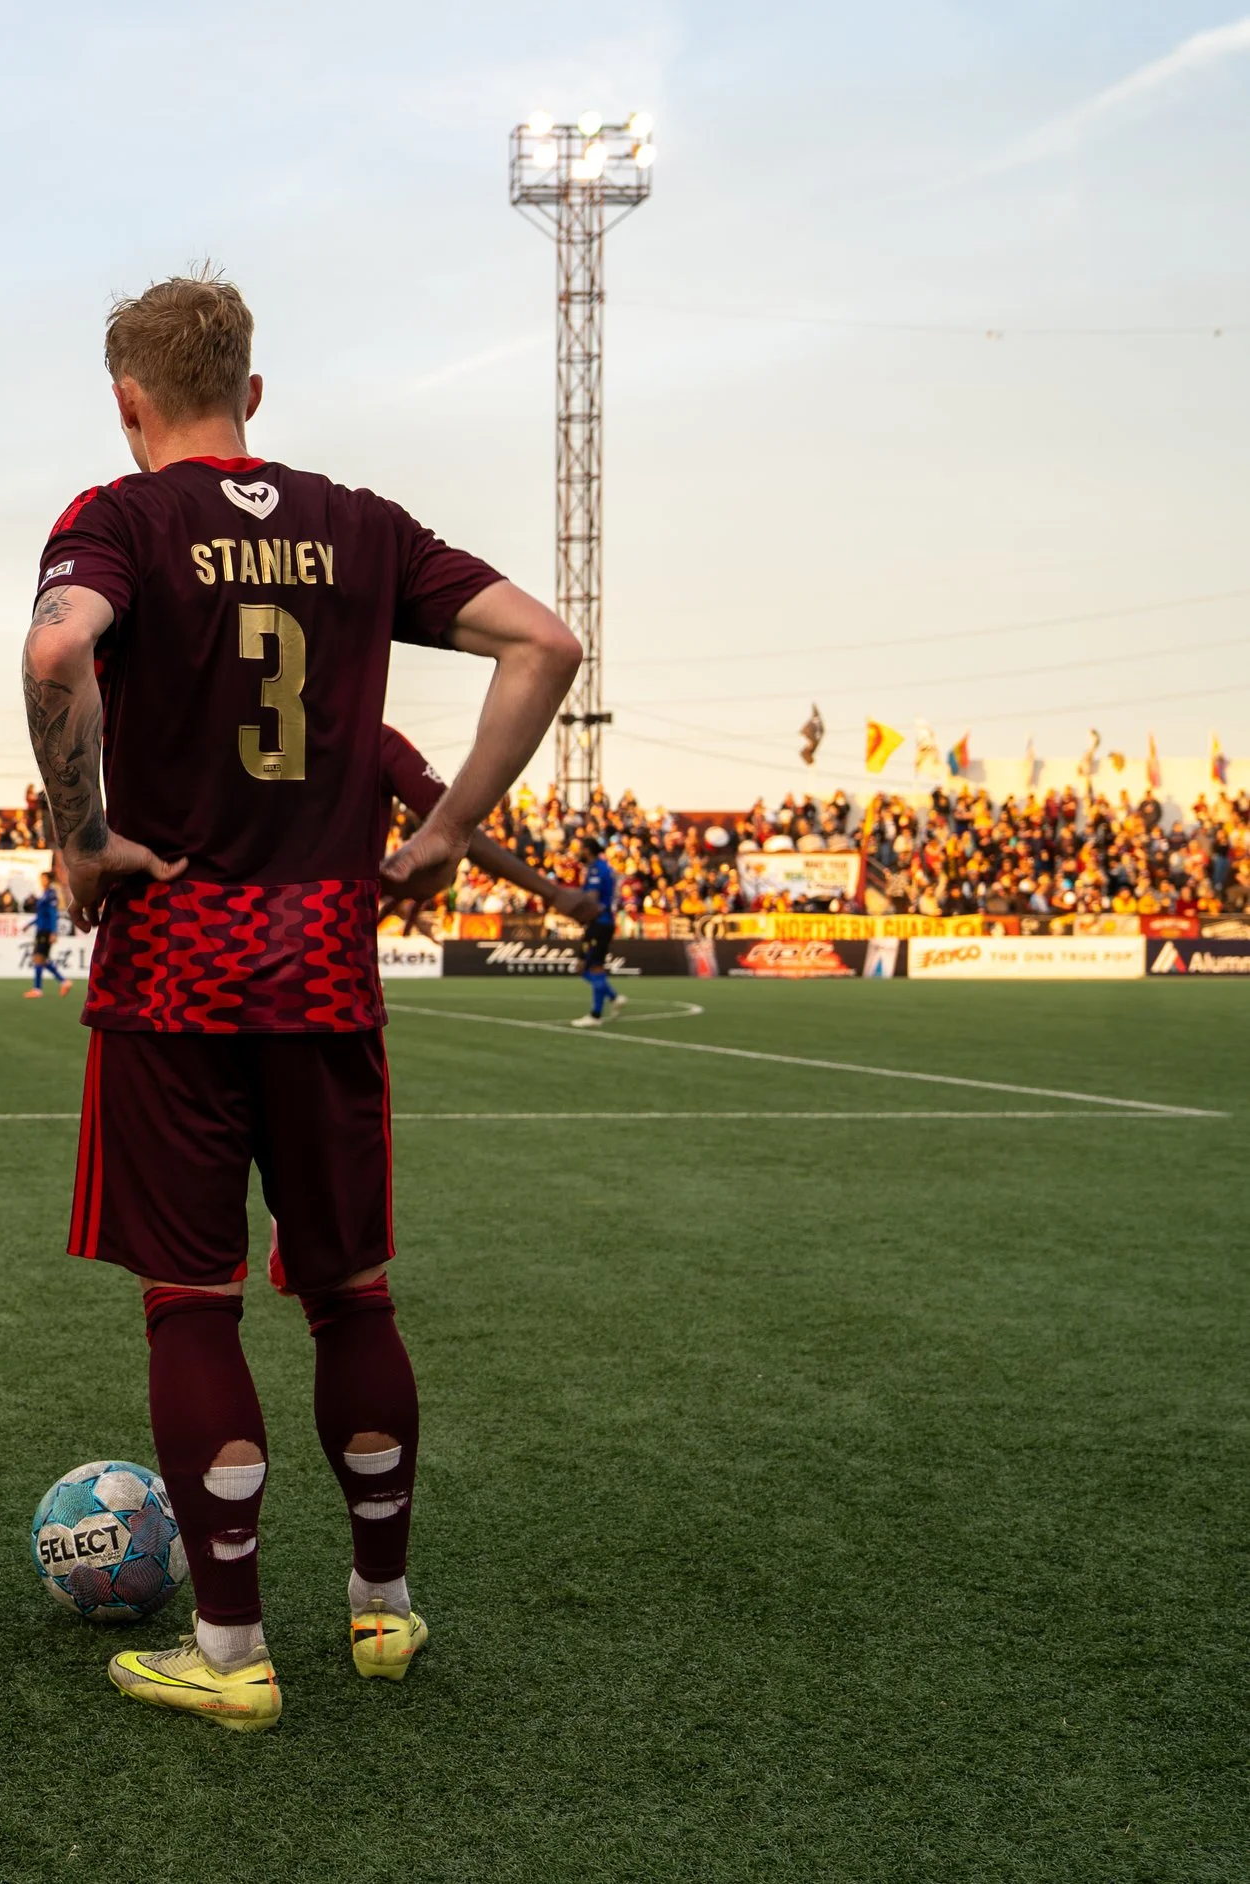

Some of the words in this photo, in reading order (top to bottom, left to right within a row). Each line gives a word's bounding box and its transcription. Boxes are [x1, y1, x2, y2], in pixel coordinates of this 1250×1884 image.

[191, 538, 334, 585] STANLEY
[238, 603, 306, 780] 3
[377, 948, 436, 966] ckets
[921, 944, 982, 968] FAYGO
[39, 1525, 119, 1565] SELECT
